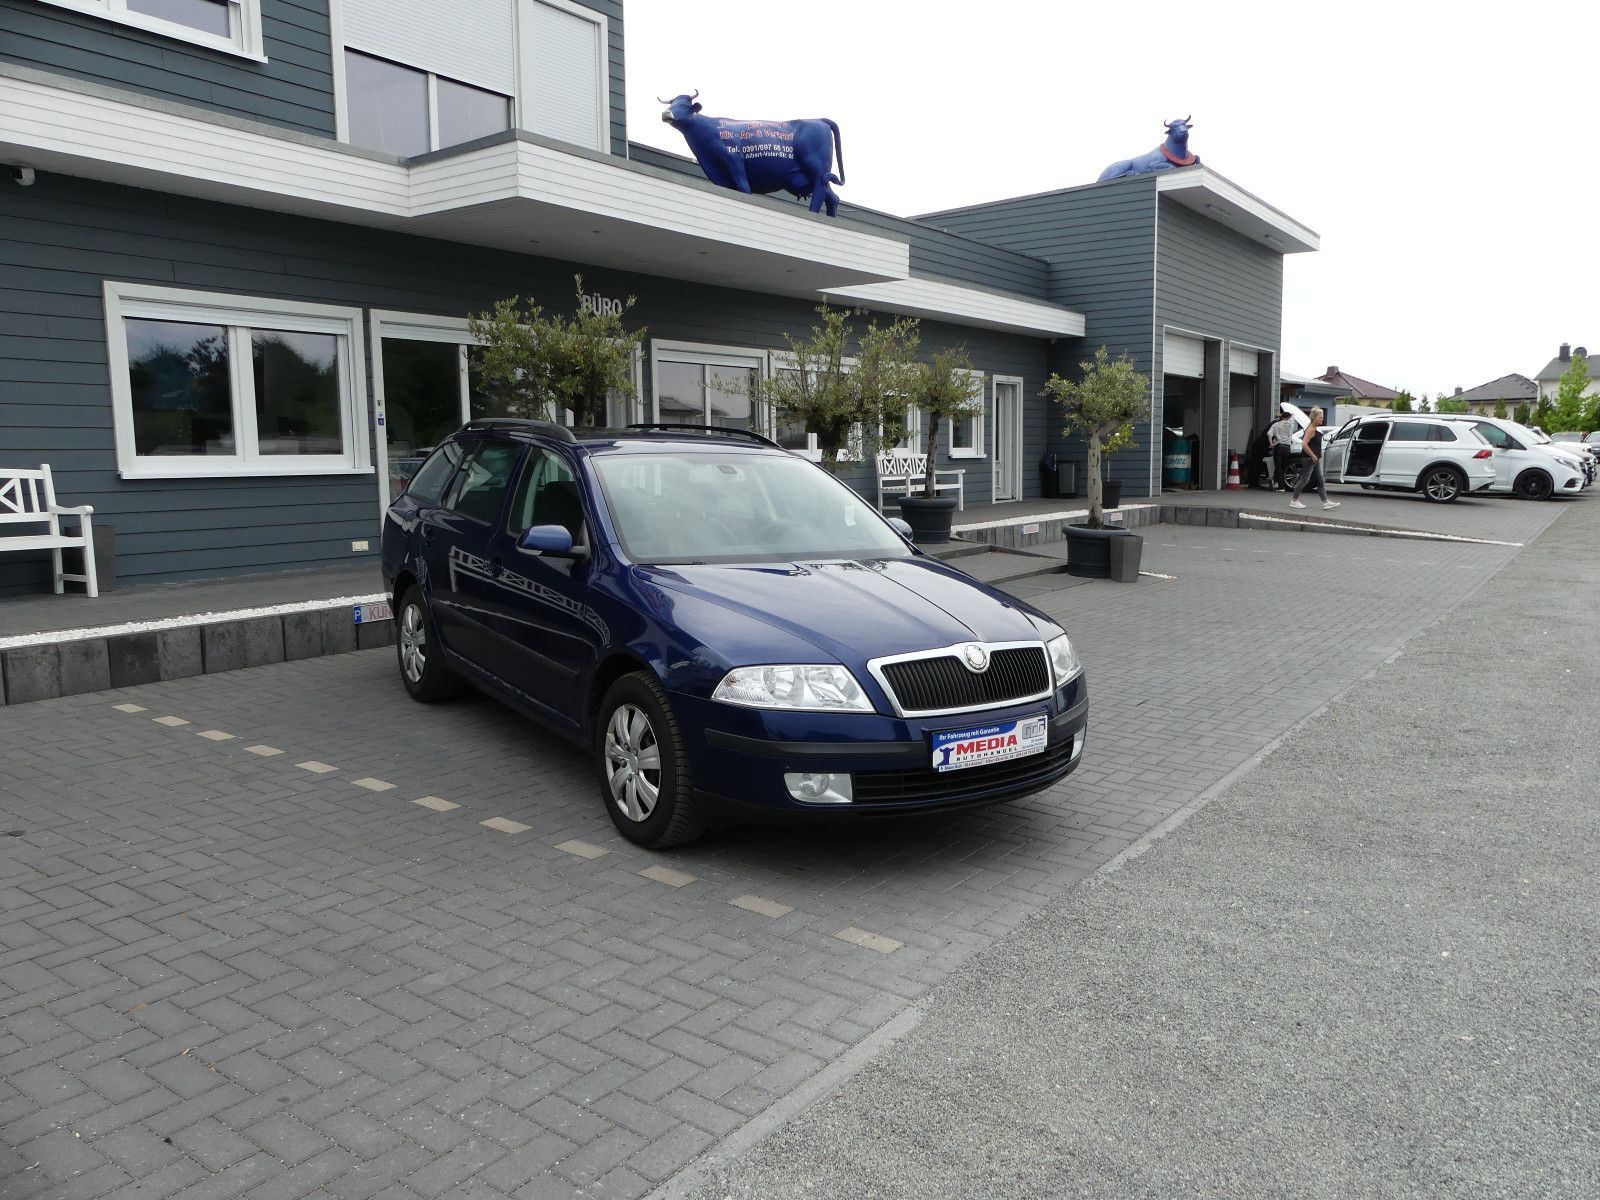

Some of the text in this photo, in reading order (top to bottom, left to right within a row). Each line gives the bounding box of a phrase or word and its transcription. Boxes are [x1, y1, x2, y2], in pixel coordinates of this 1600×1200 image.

[581, 292, 622, 317] BÜRO
[939, 733, 947, 741] Ihr
[956, 735, 1018, 755] MEDIA
[956, 747, 1018, 762] AUTOHANDEL
